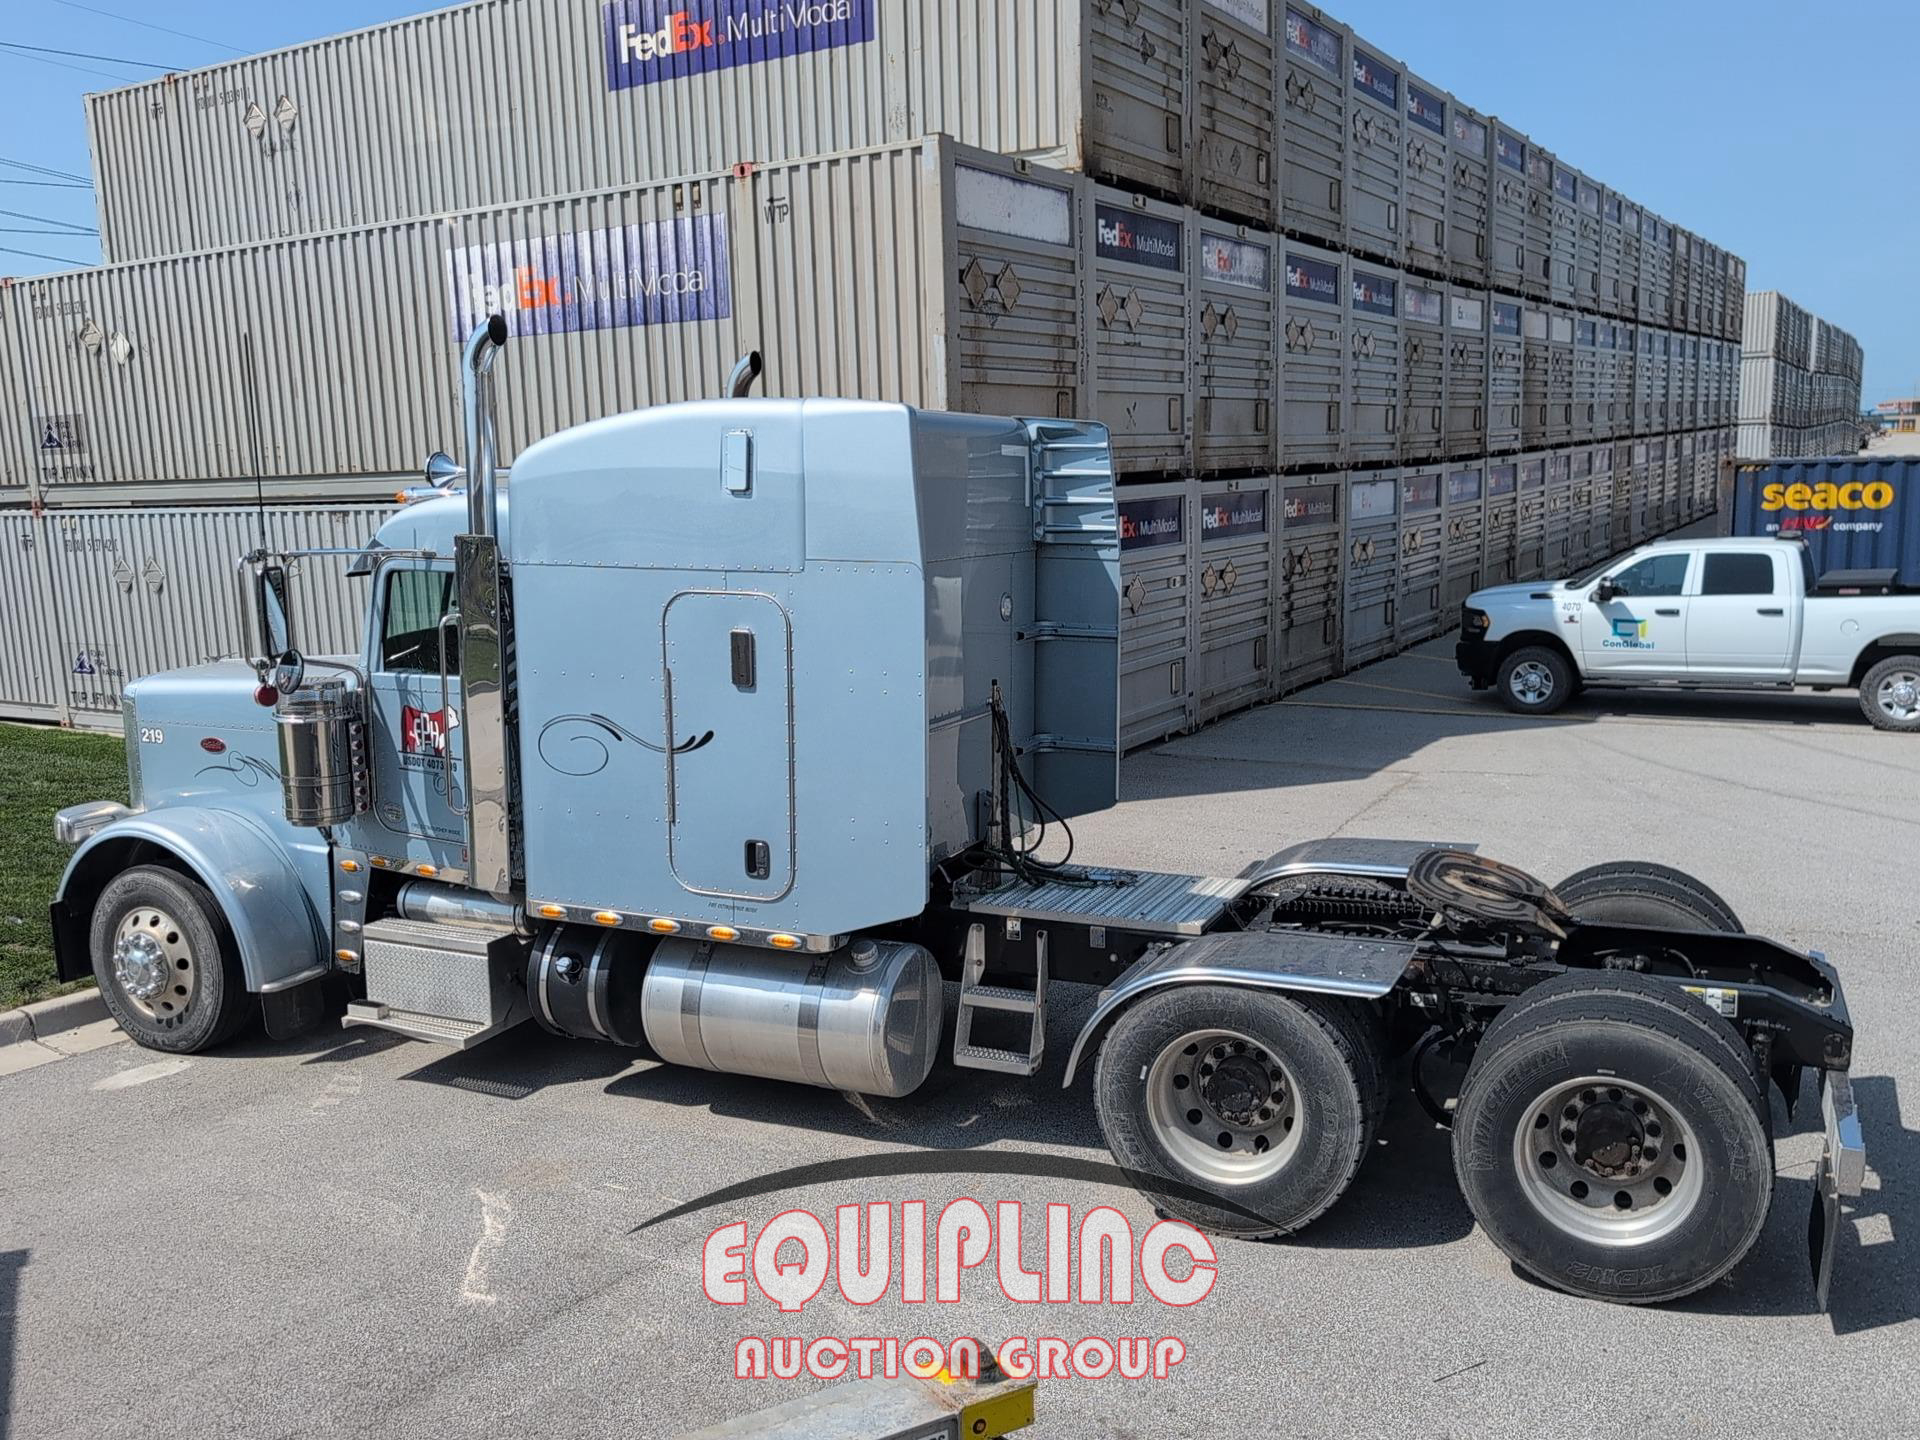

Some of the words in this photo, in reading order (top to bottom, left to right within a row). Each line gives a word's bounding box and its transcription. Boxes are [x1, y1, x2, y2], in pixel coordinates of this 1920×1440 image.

[619, 11, 713, 64] FedEx
[764, 204, 789, 225] WTP
[1097, 218, 1133, 250] FedEx
[1135, 235, 1176, 257] MultiModal
[1286, 265, 1310, 288] FedEx
[1761, 481, 1895, 511] seaco
[1202, 506, 1229, 529] FedEx
[1284, 498, 1308, 518] FedEx
[1139, 518, 1178, 537] MultiModal
[1766, 523, 1779, 531] an
[1833, 522, 1883, 532] company
[1562, 602, 1581, 611] 4070
[1602, 639, 1655, 649] ConGlobal
[140, 727, 163, 744] 219
